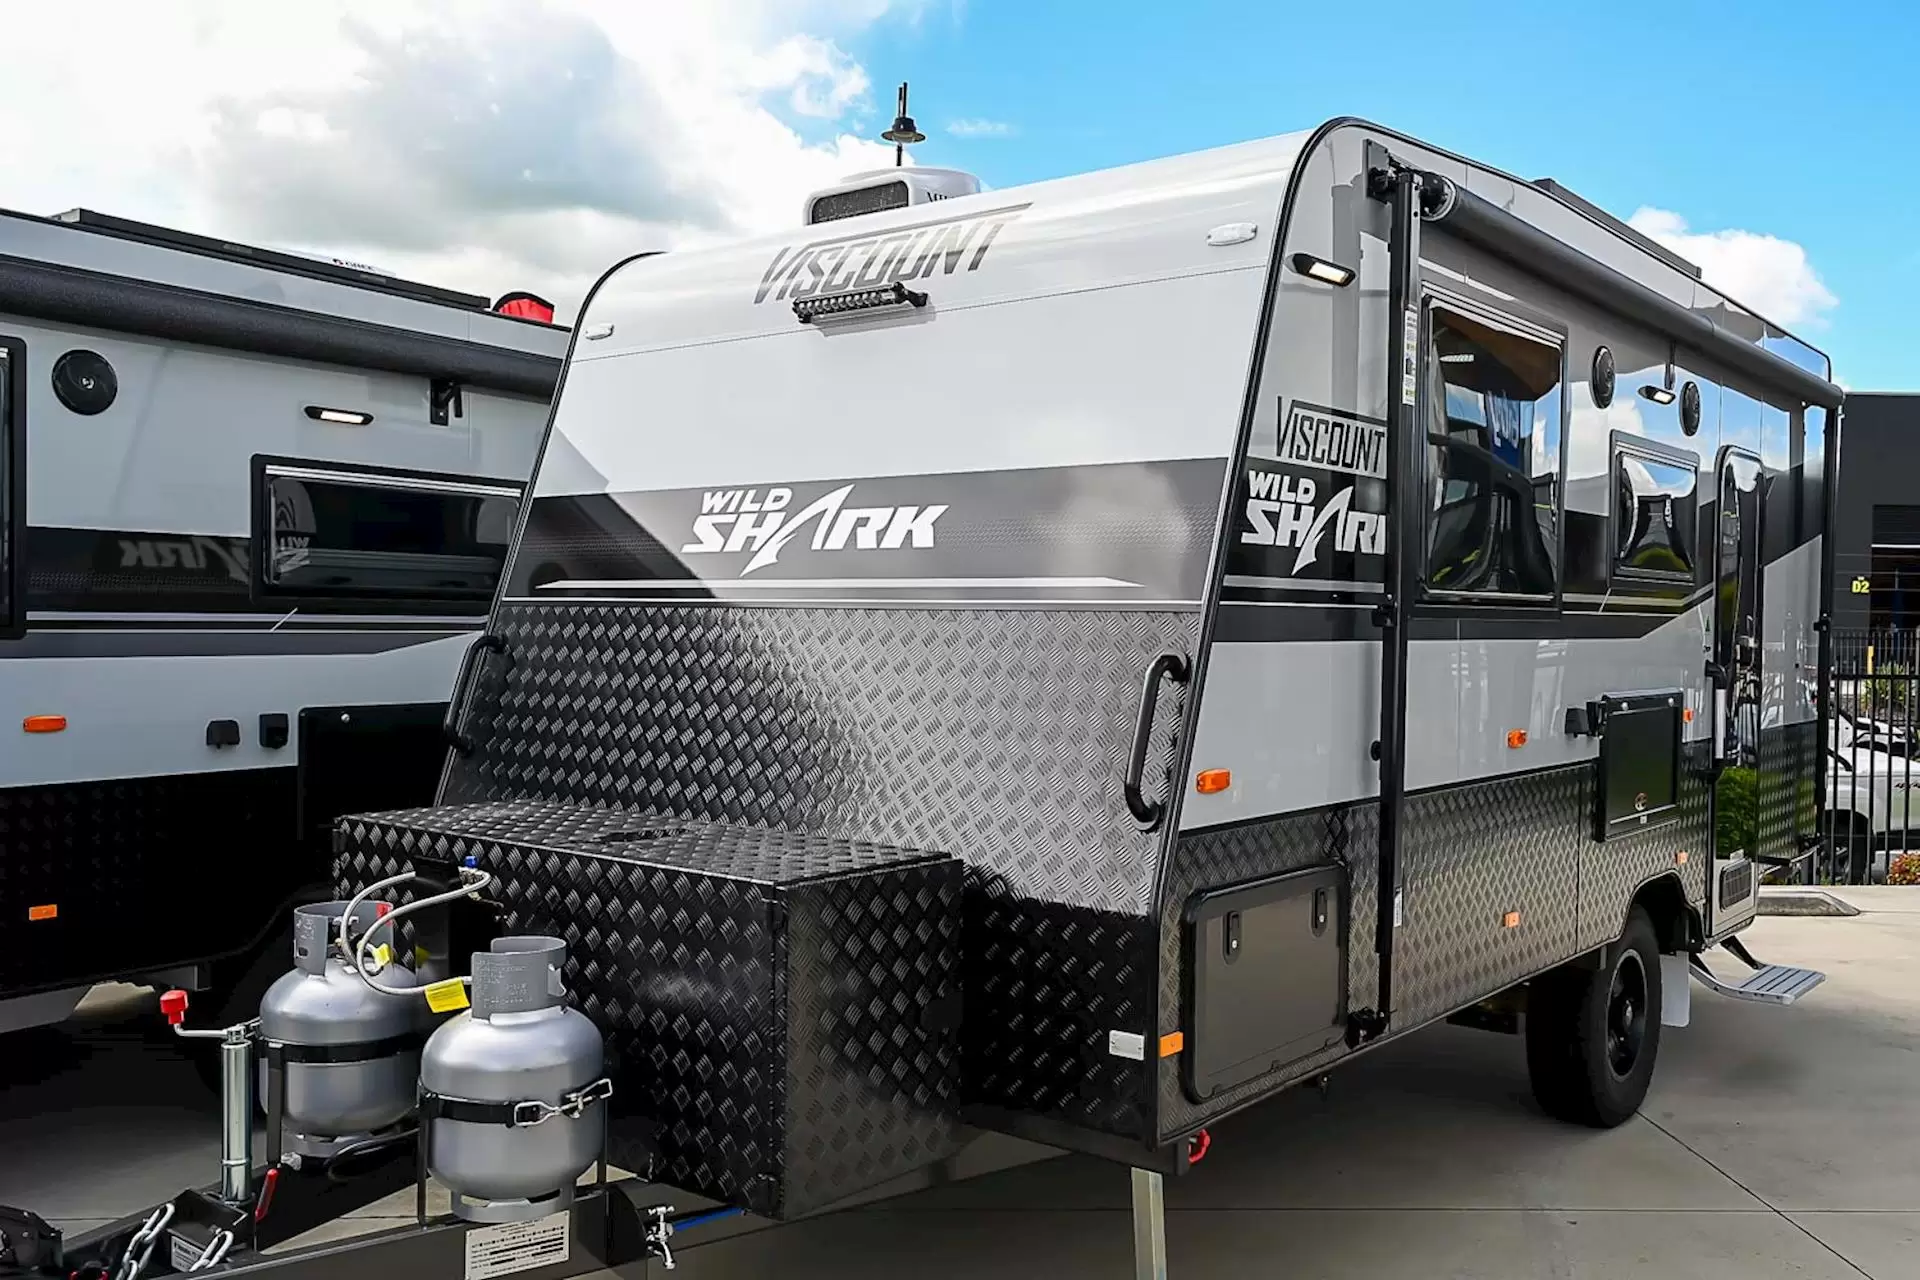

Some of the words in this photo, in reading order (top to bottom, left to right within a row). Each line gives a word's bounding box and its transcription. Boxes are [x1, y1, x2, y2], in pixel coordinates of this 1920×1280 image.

[754, 204, 1032, 304] VISCOUNT
[1276, 396, 1387, 473] VISCOUNT
[701, 486, 793, 514] WILD
[1248, 470, 1316, 504] WILD
[680, 483, 950, 577] SHARK
[1852, 580, 1870, 593] D2
